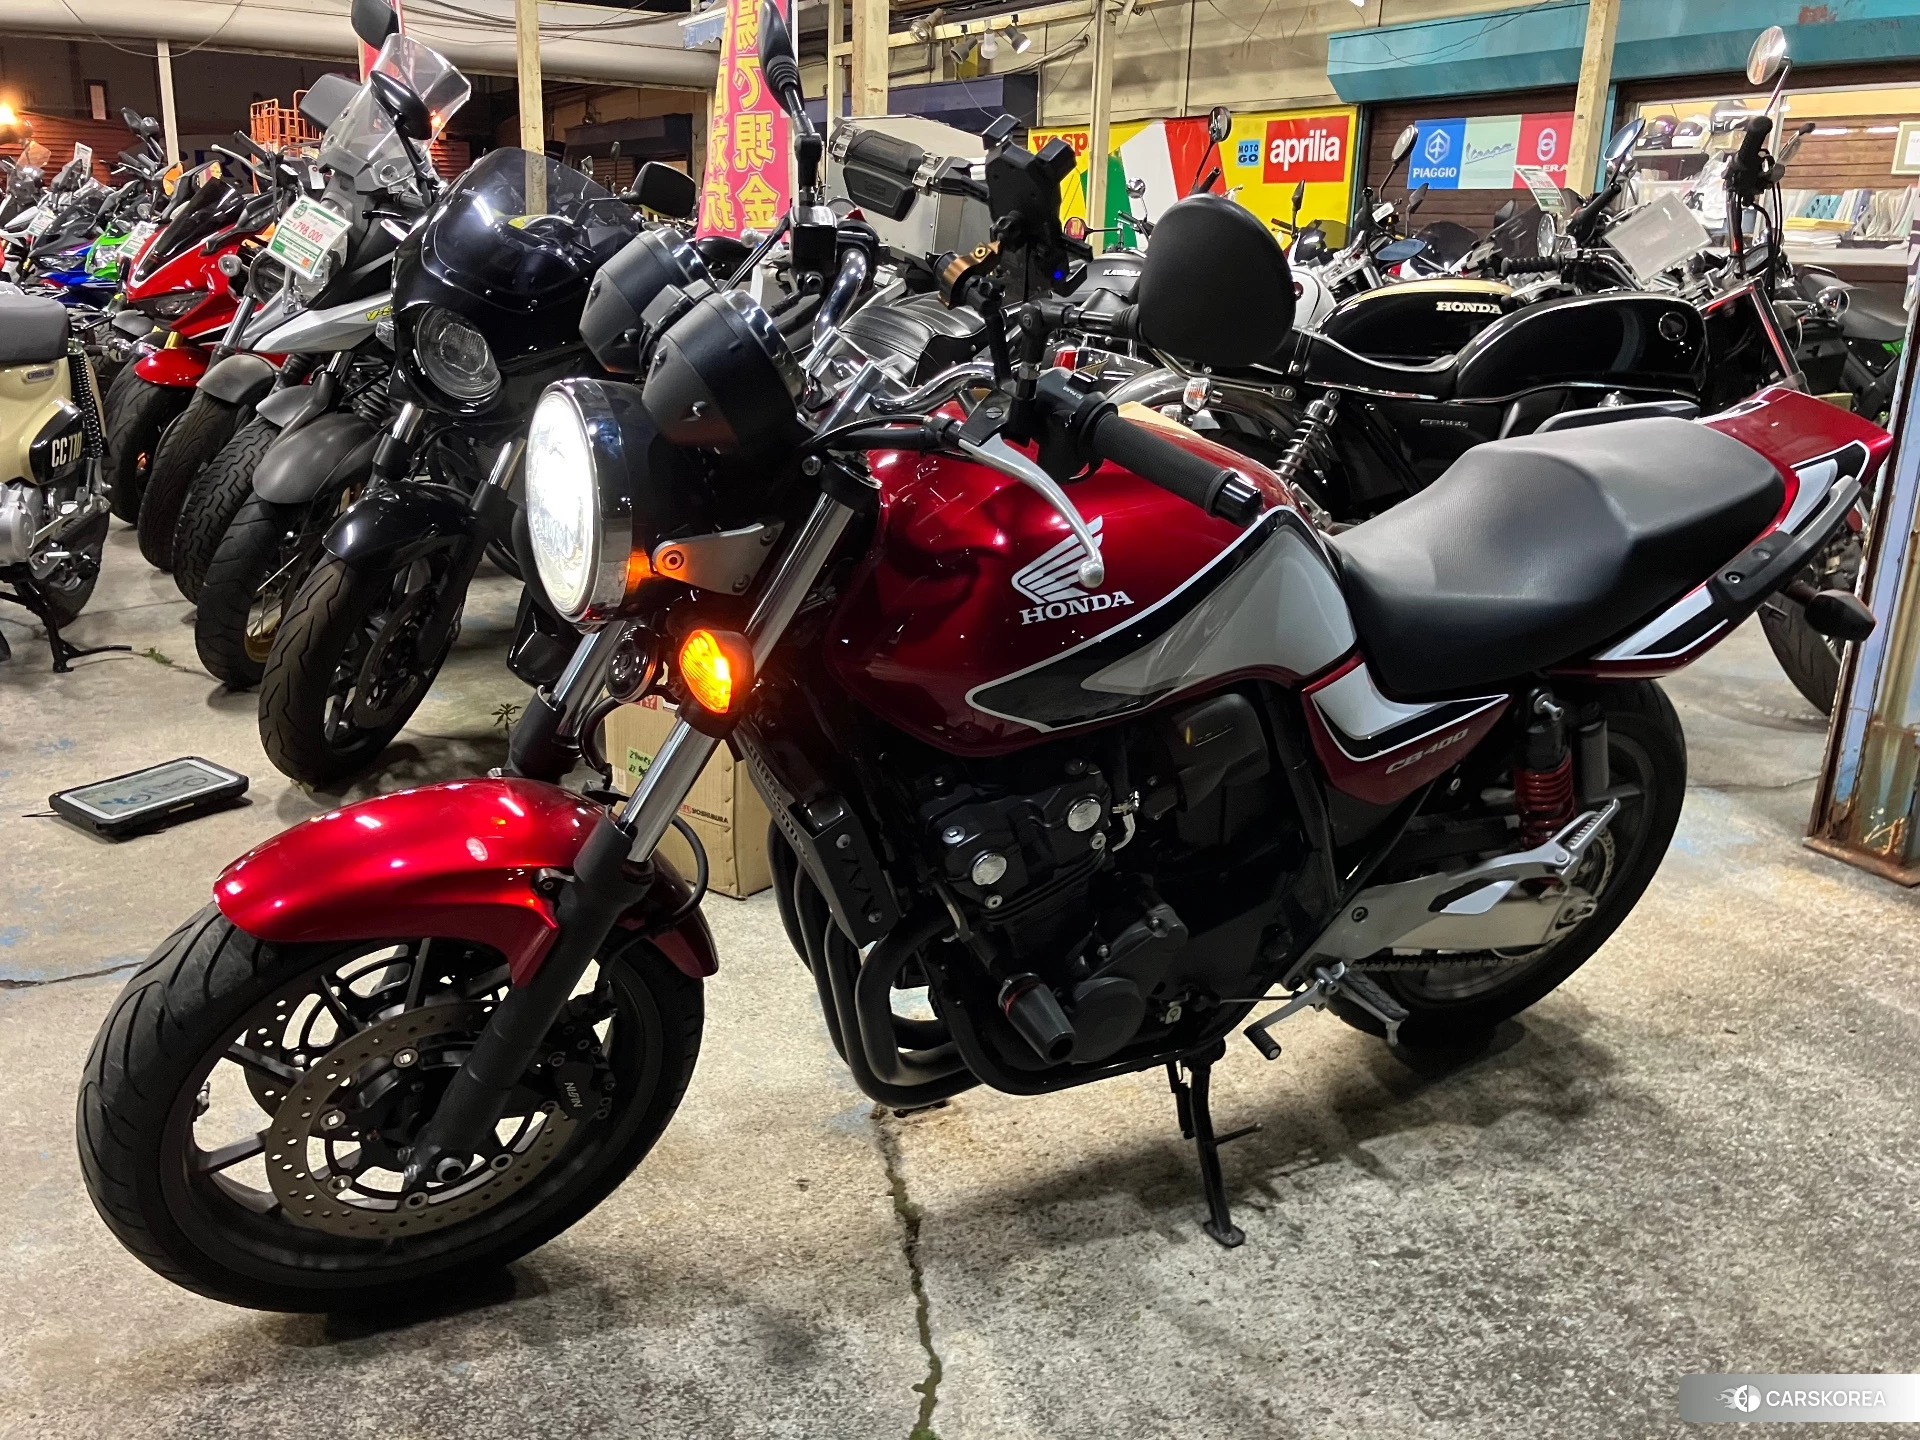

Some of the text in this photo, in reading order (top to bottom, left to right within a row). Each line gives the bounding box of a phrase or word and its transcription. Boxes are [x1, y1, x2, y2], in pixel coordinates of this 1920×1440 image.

[1033, 132, 1090, 157] vsp
[1238, 142, 1259, 153] MOTO
[1269, 128, 1341, 172] aprilia
[1237, 153, 1259, 164] GO
[1412, 167, 1457, 179] PIAGGIO
[1542, 164, 1568, 173] ERA
[1436, 301, 1503, 315] HONDA
[1019, 590, 1135, 625] HONDA
